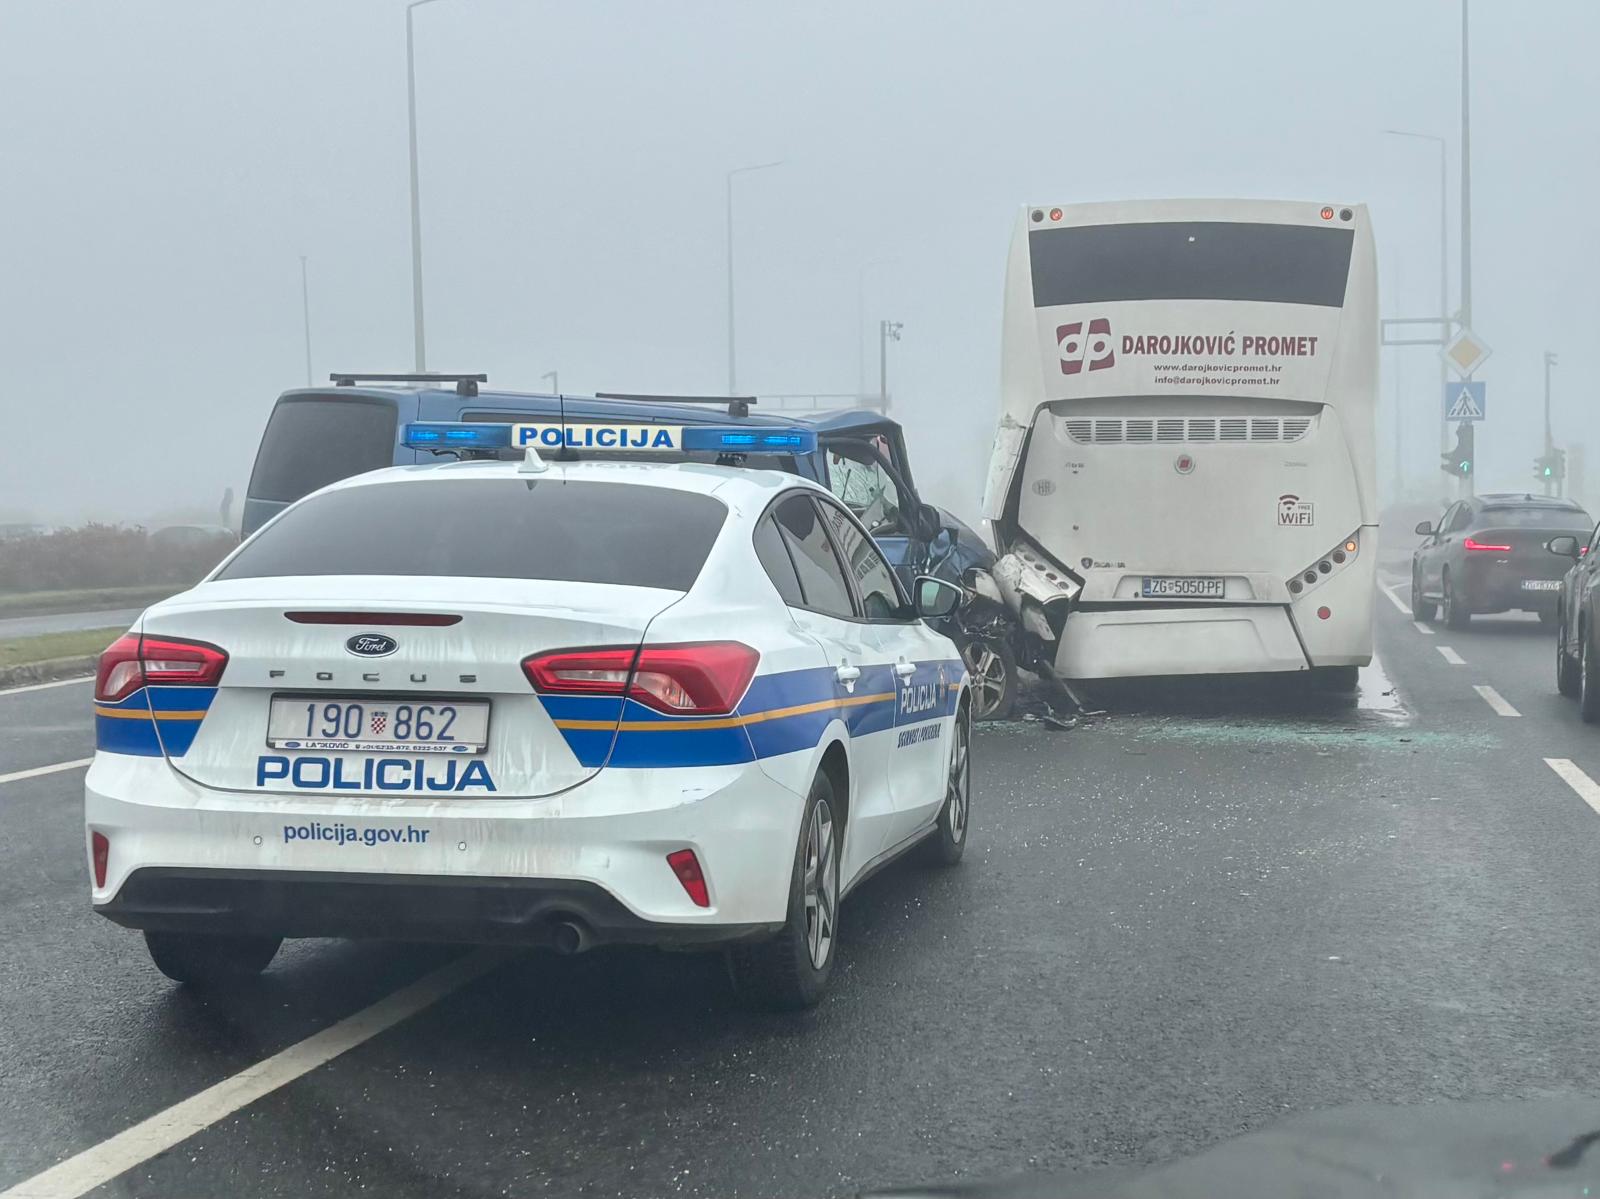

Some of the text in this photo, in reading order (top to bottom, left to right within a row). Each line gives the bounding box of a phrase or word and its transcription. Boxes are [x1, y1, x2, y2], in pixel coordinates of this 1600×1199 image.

[1121, 331, 1318, 356] DAROJKOVIĆ PROMET
[1153, 363, 1283, 373] www.darojkovicpromet.hr
[1154, 376, 1281, 386] info@darojkovicpromet.hr
[519, 427, 674, 448] POLICIJA
[1281, 512, 1311, 524] WiFi
[1152, 580, 1167, 594] ZG
[355, 637, 387, 653] Ford
[269, 670, 477, 684] FOCUS
[900, 682, 937, 715] POLICIJA
[305, 703, 458, 742] 190 862
[256, 756, 497, 792] POLICIJA
[284, 823, 430, 846] policija.gov.hr
